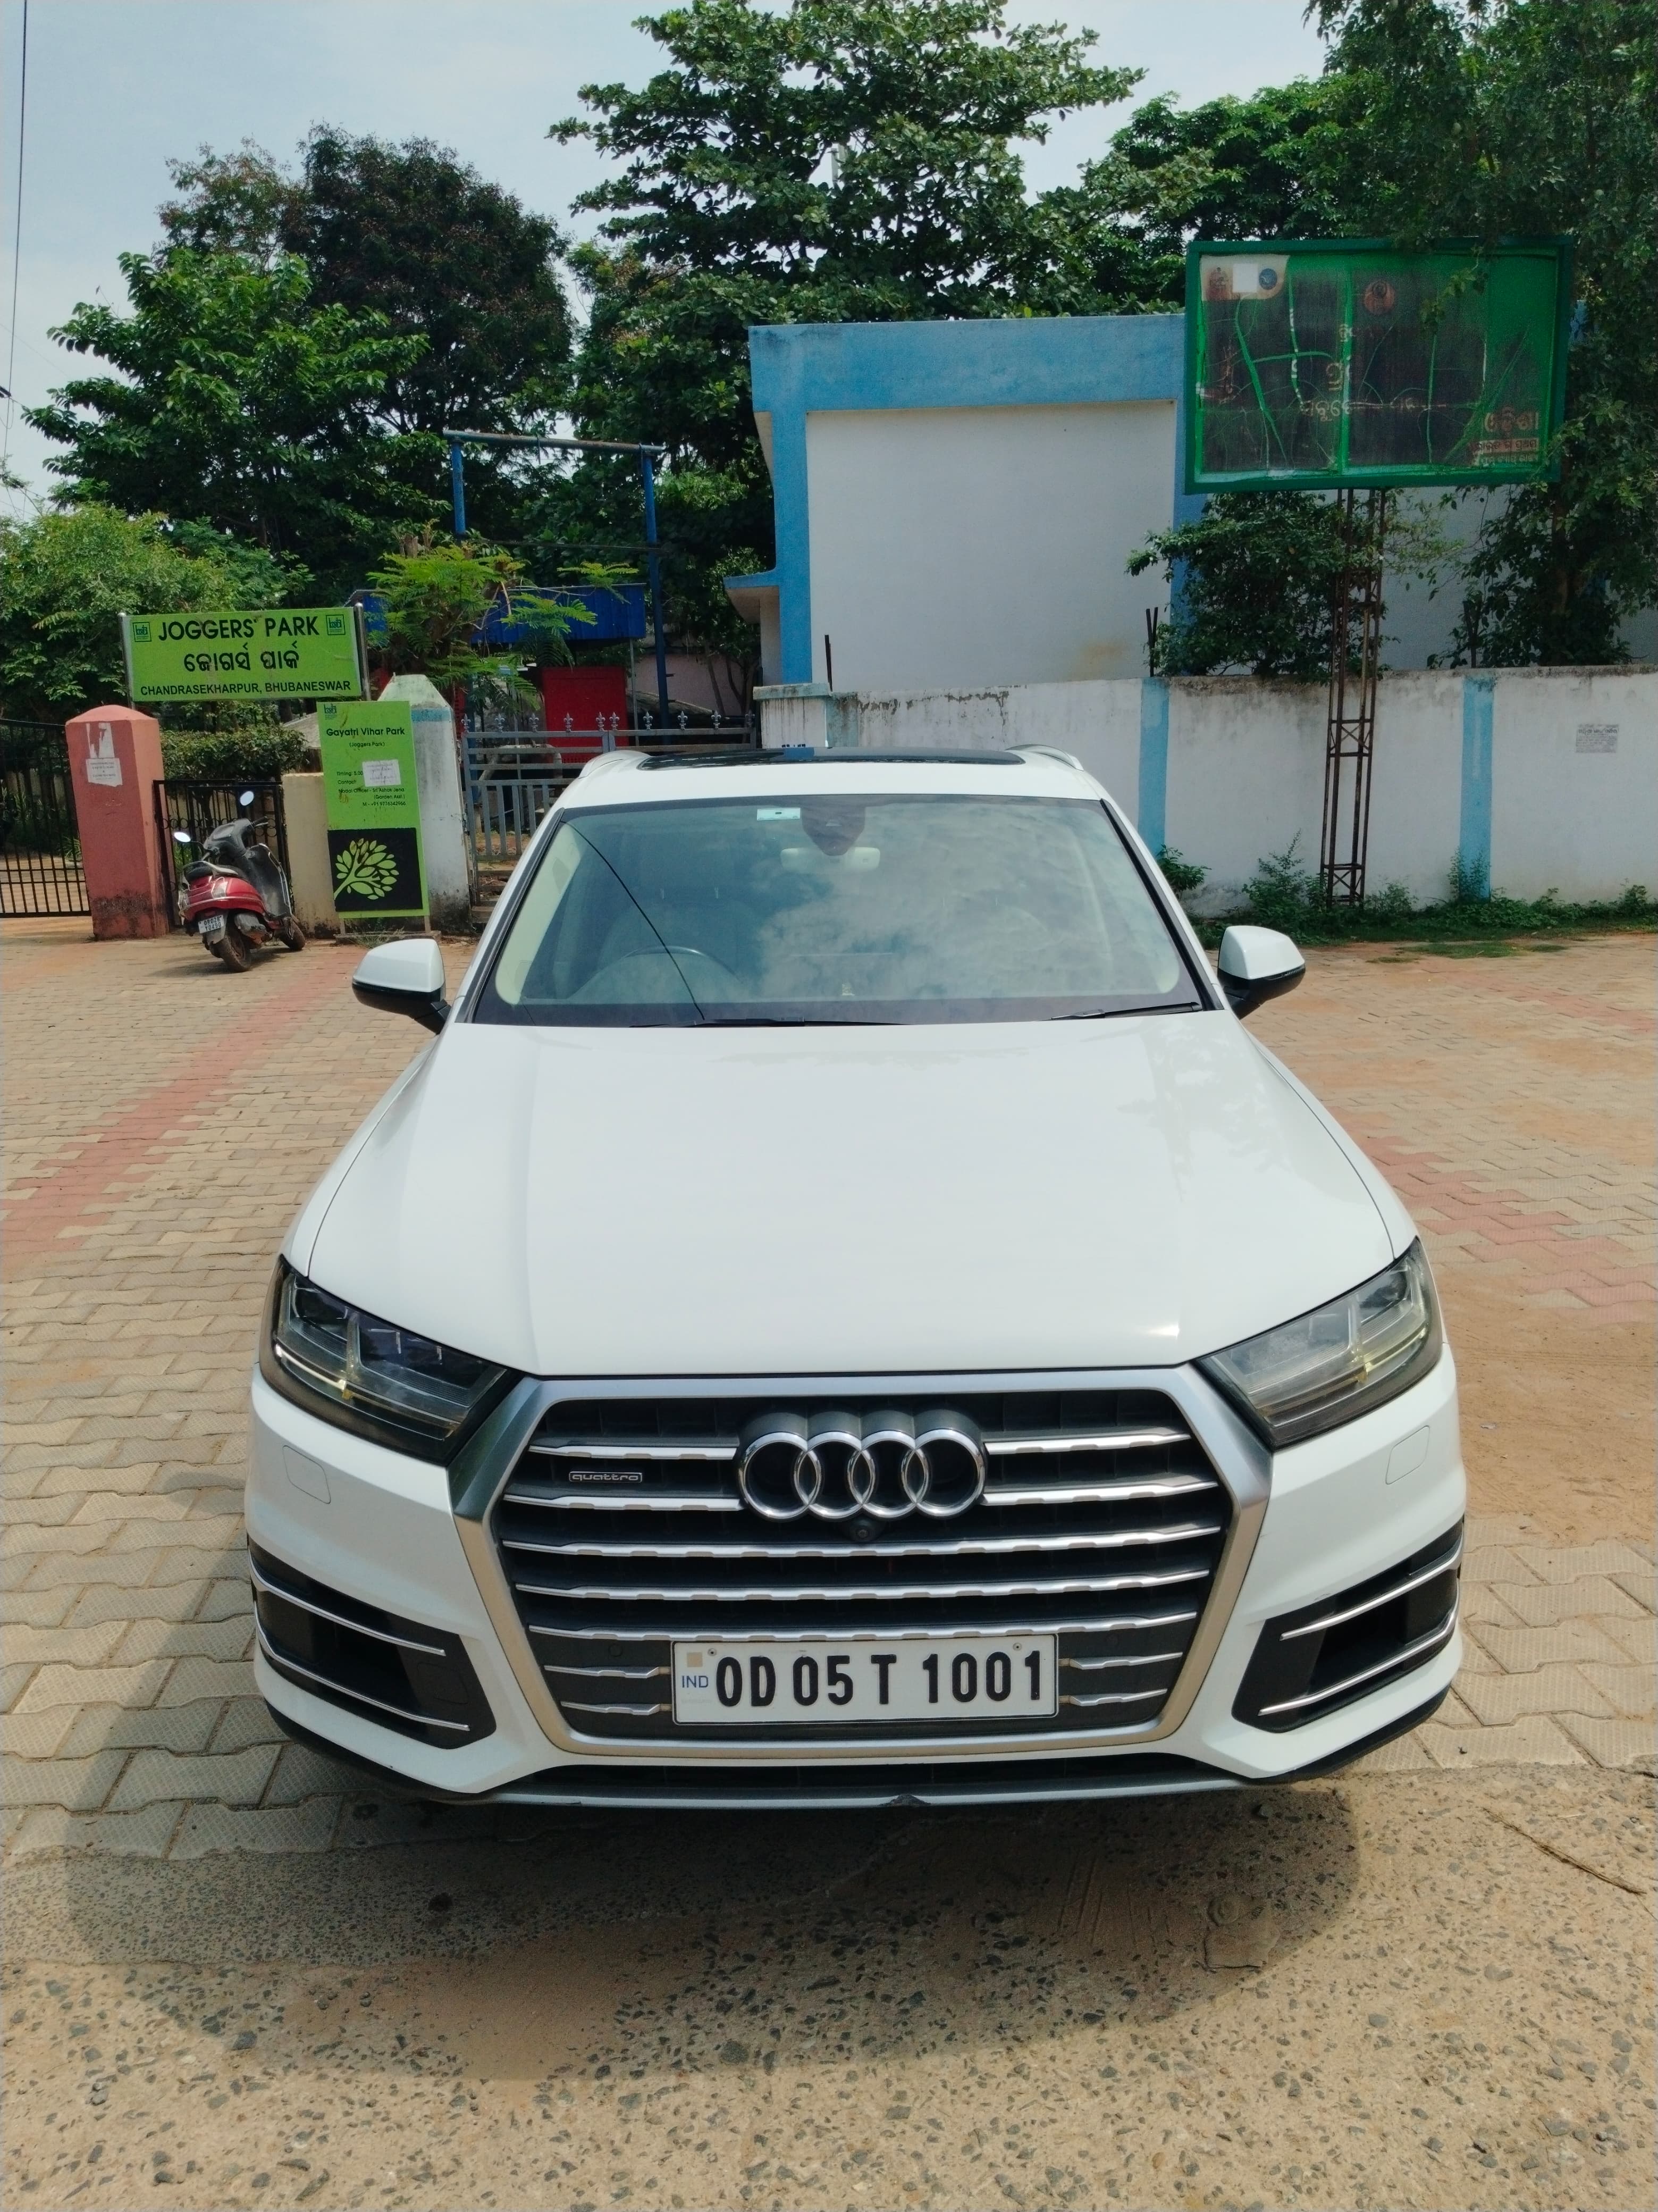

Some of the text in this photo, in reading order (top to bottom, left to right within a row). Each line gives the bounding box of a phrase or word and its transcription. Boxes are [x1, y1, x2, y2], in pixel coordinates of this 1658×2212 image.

[158, 616, 319, 641] JOGGERS' PARK
[260, 640, 299, 669] ପାର୍କ
[140, 681, 350, 696] CHANDRASEKHARPUR, BHUBANESWAR
[326, 728, 358, 738] Gayatri
[681, 1650, 1040, 1707] IND OD 05 T 1001
